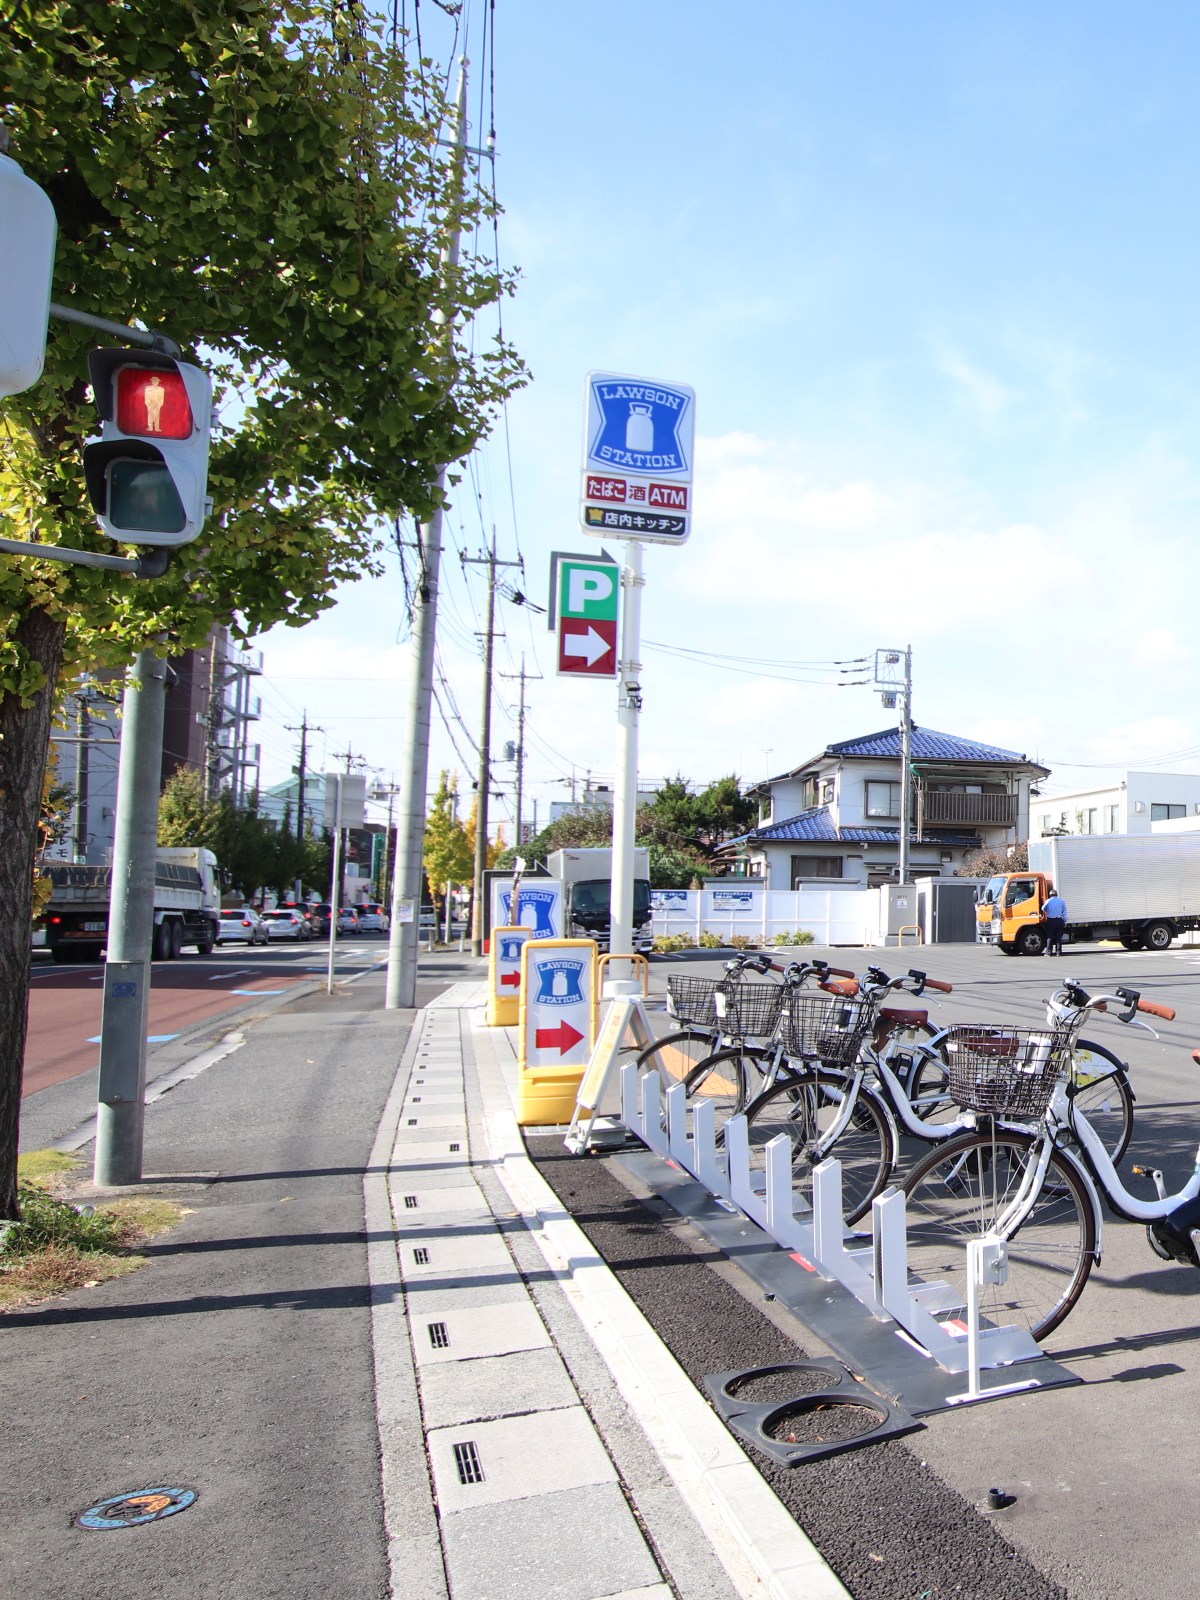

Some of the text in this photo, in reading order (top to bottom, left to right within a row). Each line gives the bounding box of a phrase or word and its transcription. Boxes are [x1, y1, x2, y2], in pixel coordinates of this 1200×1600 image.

[601, 386, 681, 410] LAWSON
[600, 445, 678, 467] STATION
[588, 479, 685, 506] たばこ 酒 ATM
[604, 511, 683, 532] 店内キッチン
[568, 568, 613, 613] P
[505, 893, 552, 903] LWSON
[539, 961, 582, 972] LAWSON
[538, 993, 580, 1004] STATION
